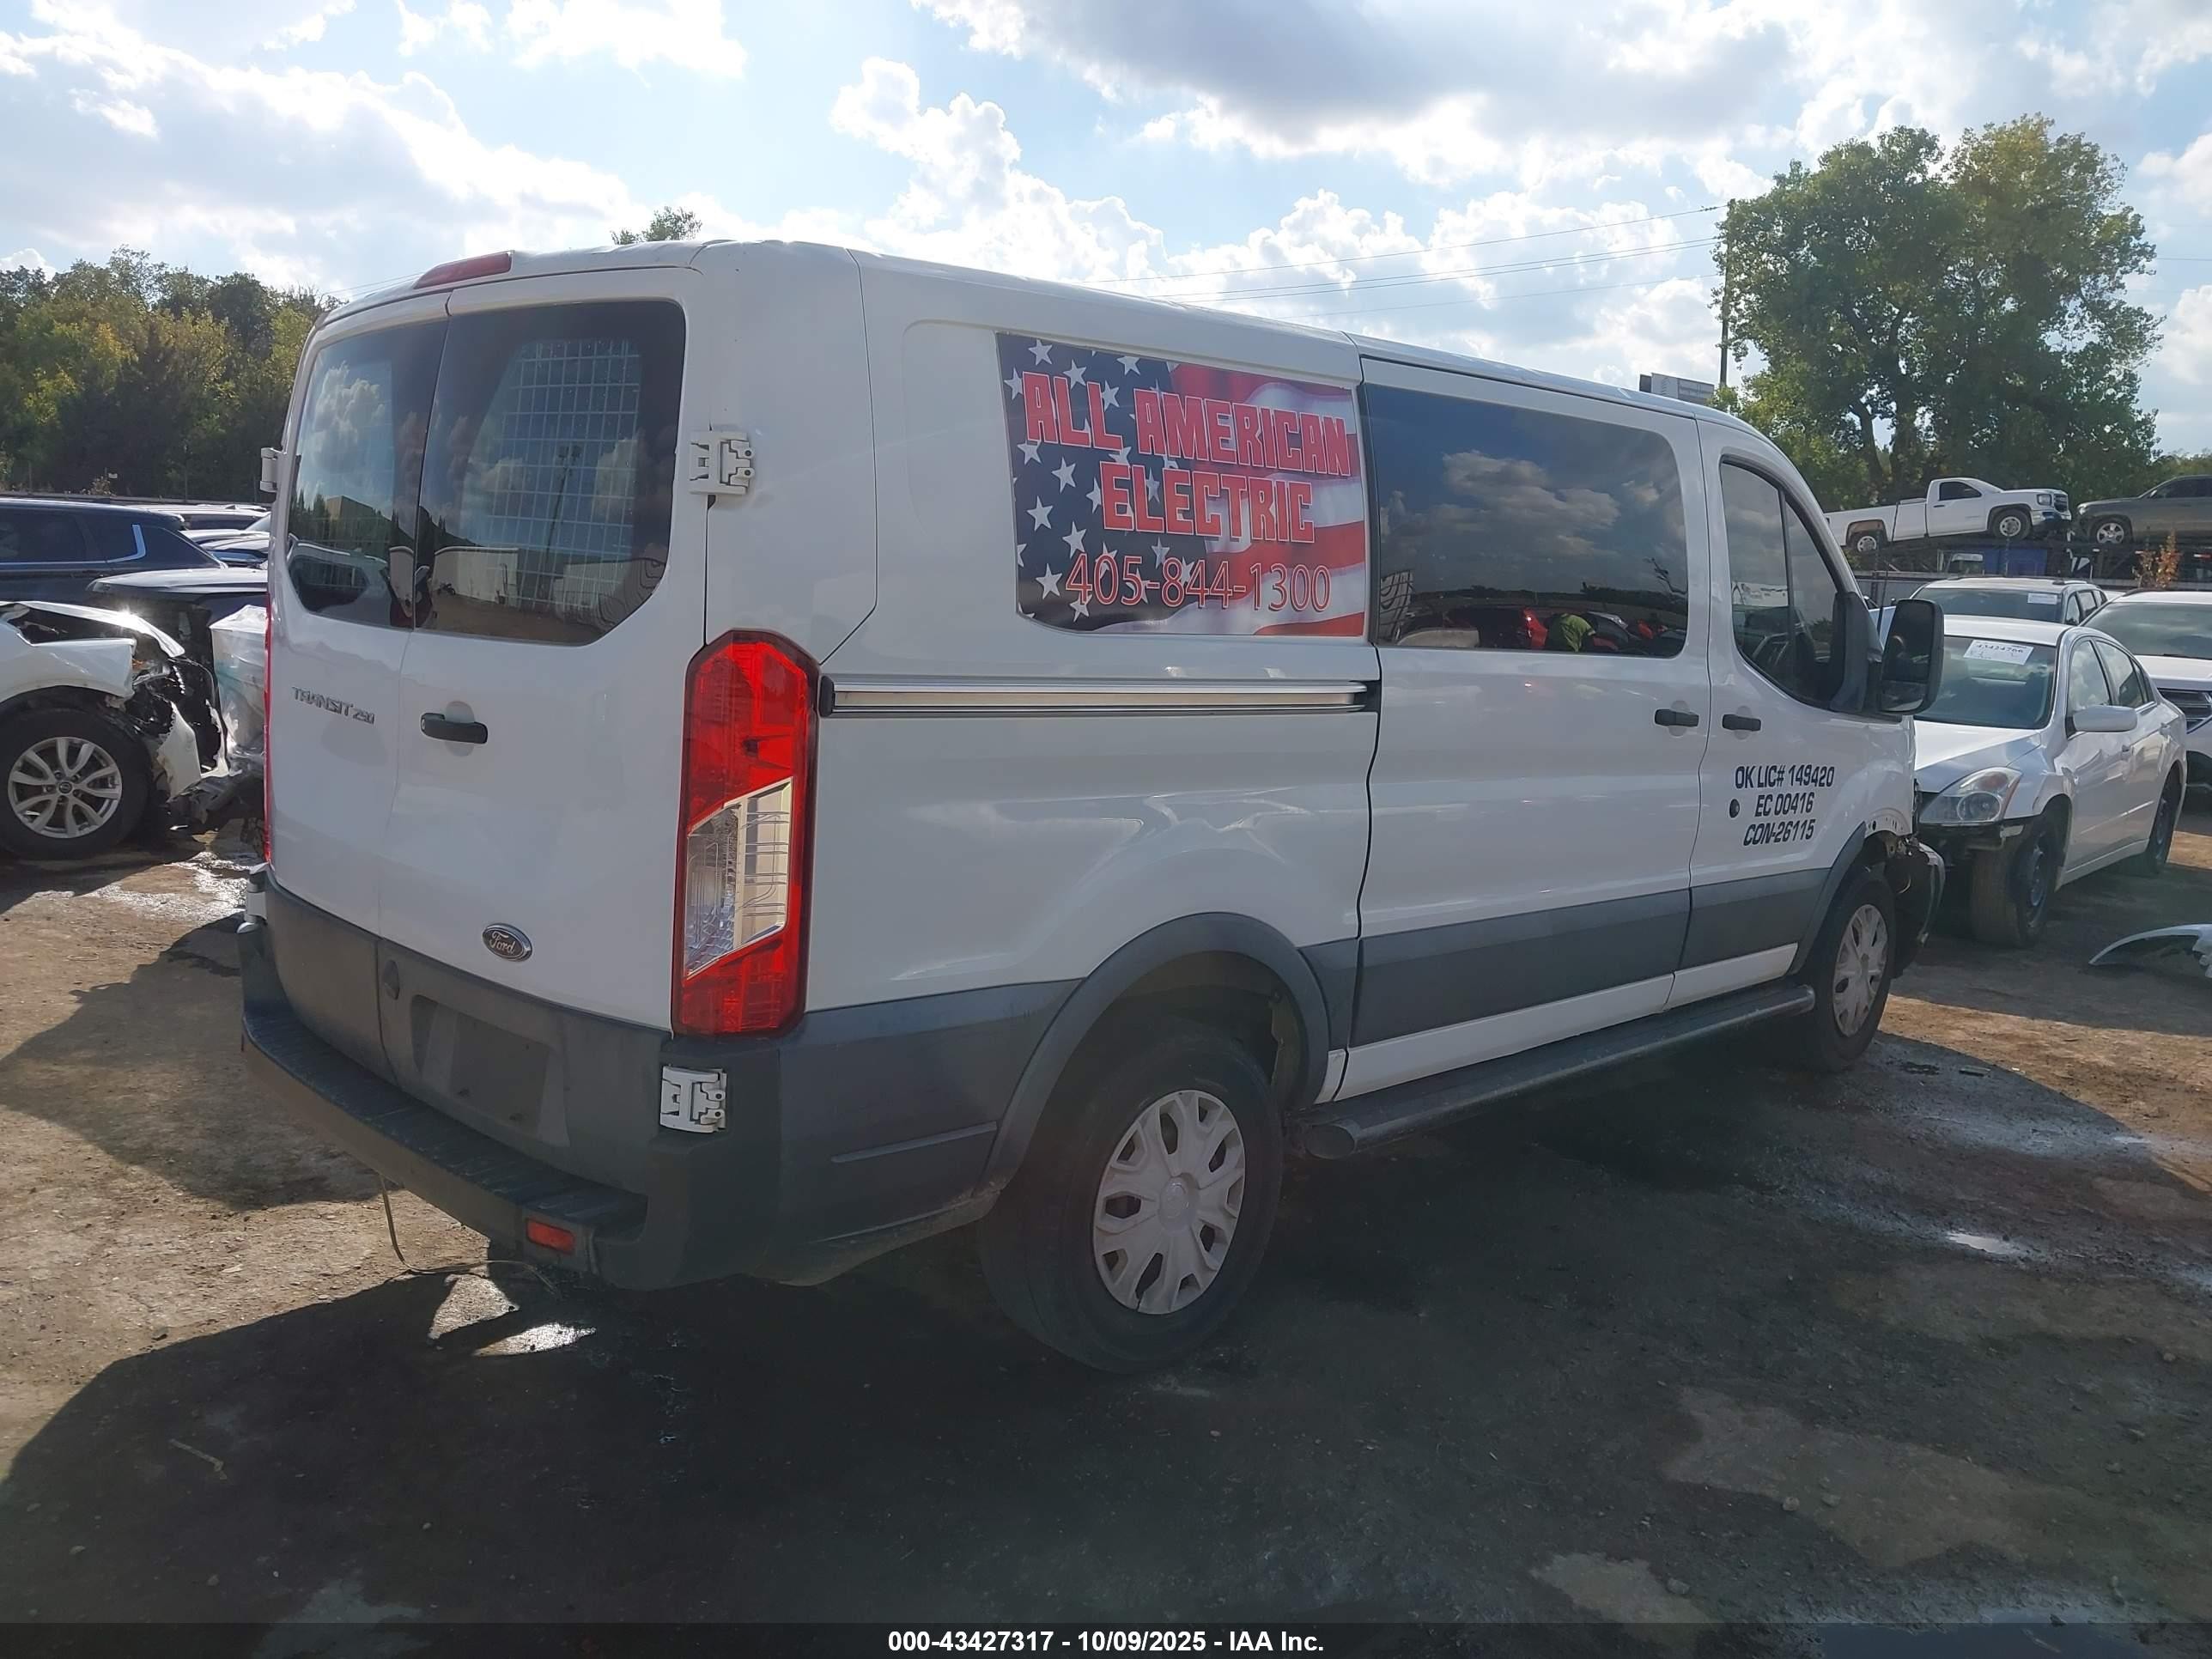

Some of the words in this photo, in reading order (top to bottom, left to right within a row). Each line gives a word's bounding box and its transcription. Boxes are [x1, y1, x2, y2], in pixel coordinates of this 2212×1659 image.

[1022, 371, 1123, 451] ALL
[1133, 387, 1352, 477] AMERICAN
[1099, 460, 1316, 544] ELECTRIC
[1065, 553, 1331, 612] 405-844-1300
[292, 686, 353, 716] TRANSIT
[1735, 765, 1755, 788] OK
[1757, 764, 1785, 787] LIC#
[1789, 764, 1835, 787] 149420
[1754, 794, 1773, 817] EC
[1774, 792, 1814, 816] 00416
[1743, 819, 1816, 846] CON-26115
[489, 930, 516, 954] Ford
